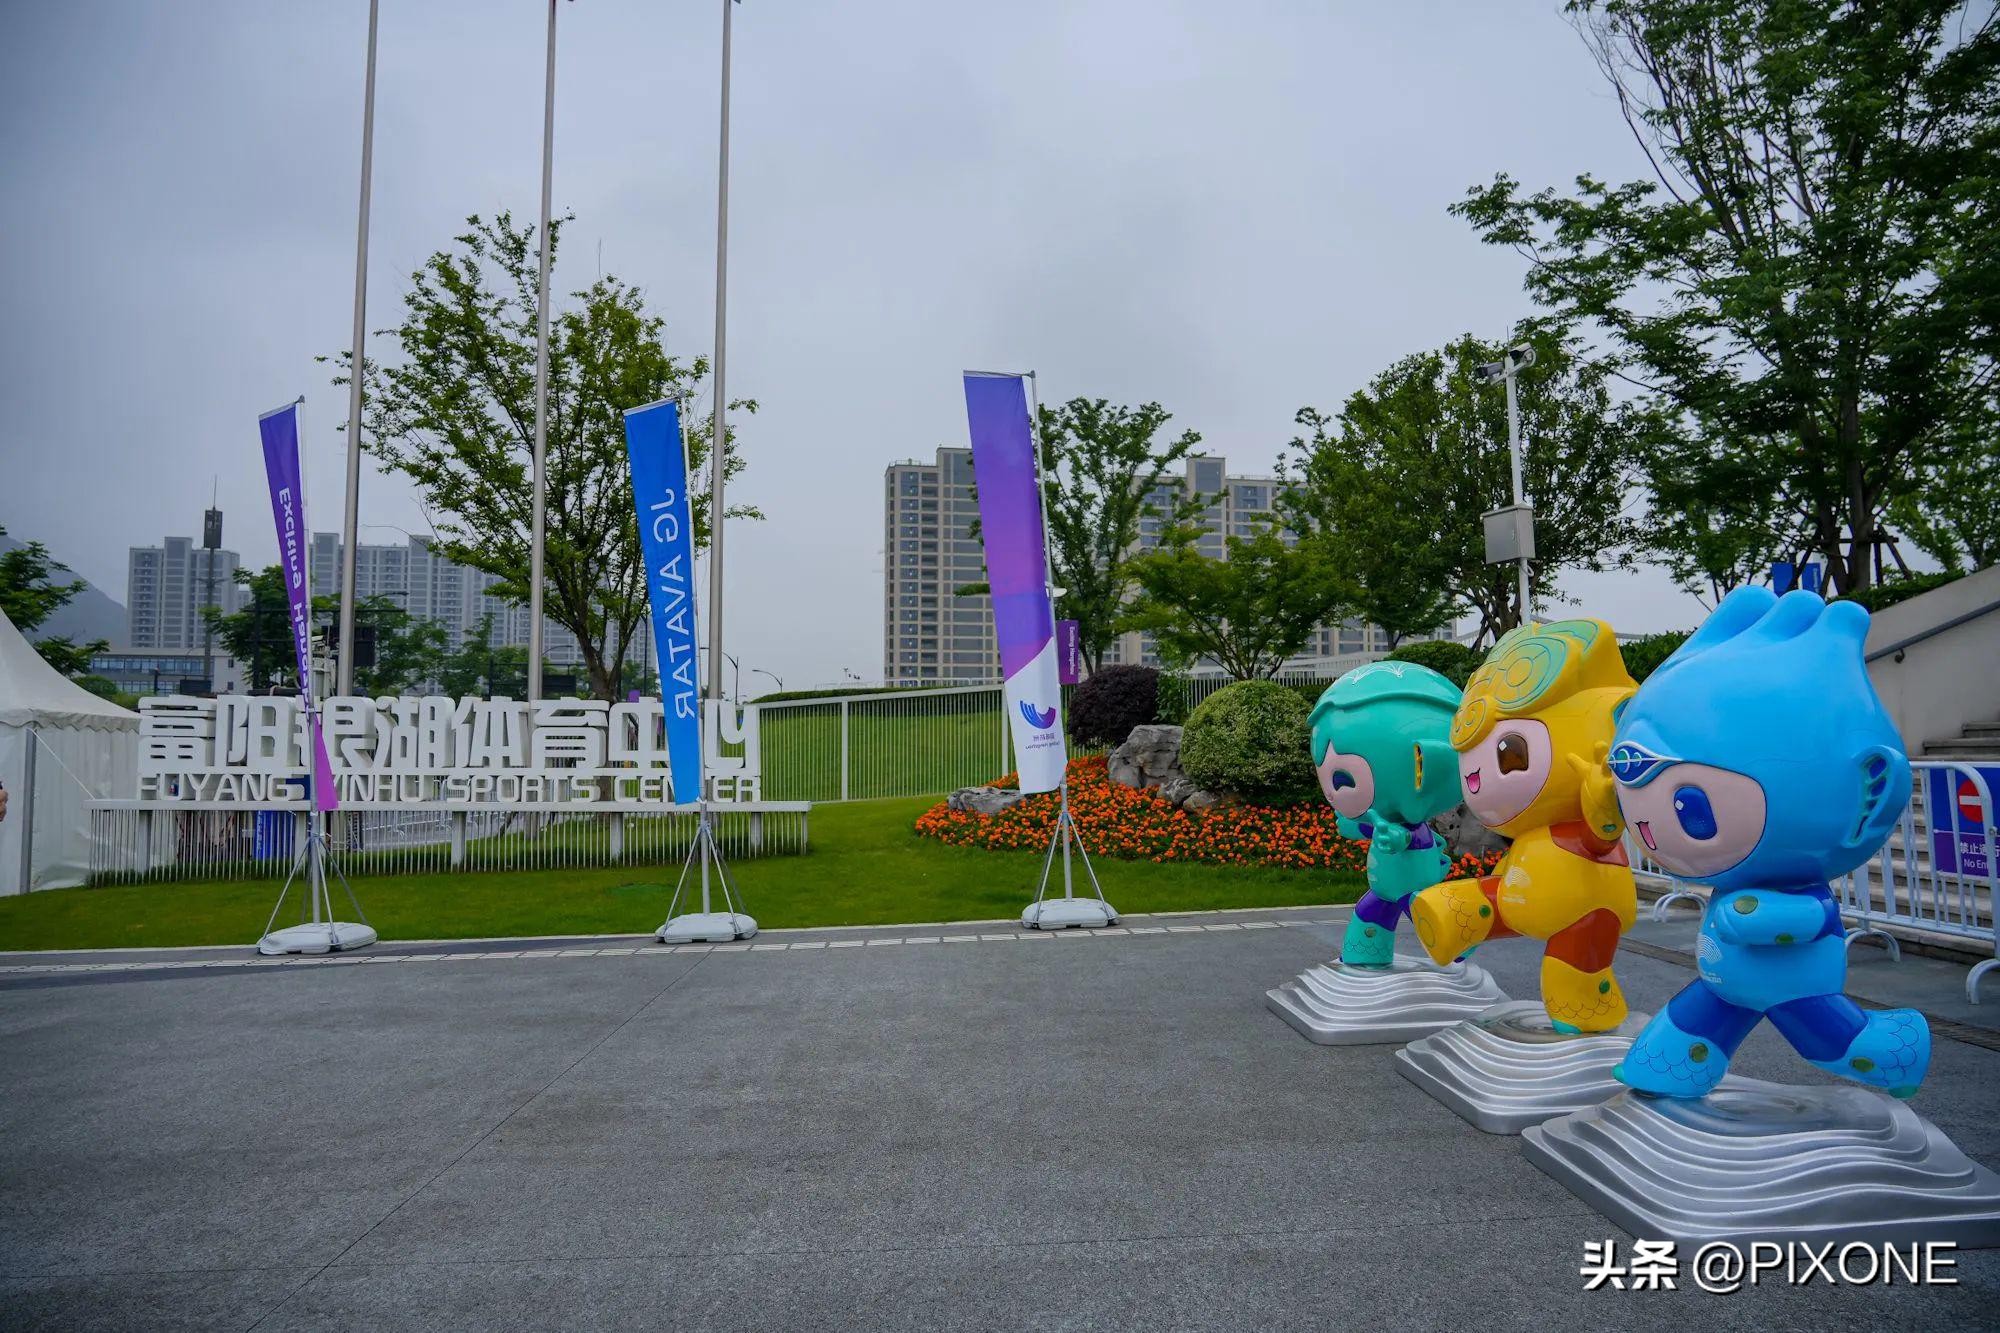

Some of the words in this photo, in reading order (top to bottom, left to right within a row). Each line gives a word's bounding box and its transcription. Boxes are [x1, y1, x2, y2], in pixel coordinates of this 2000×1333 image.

[139, 773, 306, 802] FUYANG
[447, 775, 601, 803] SPORTS
[1964, 859, 1975, 868] No
